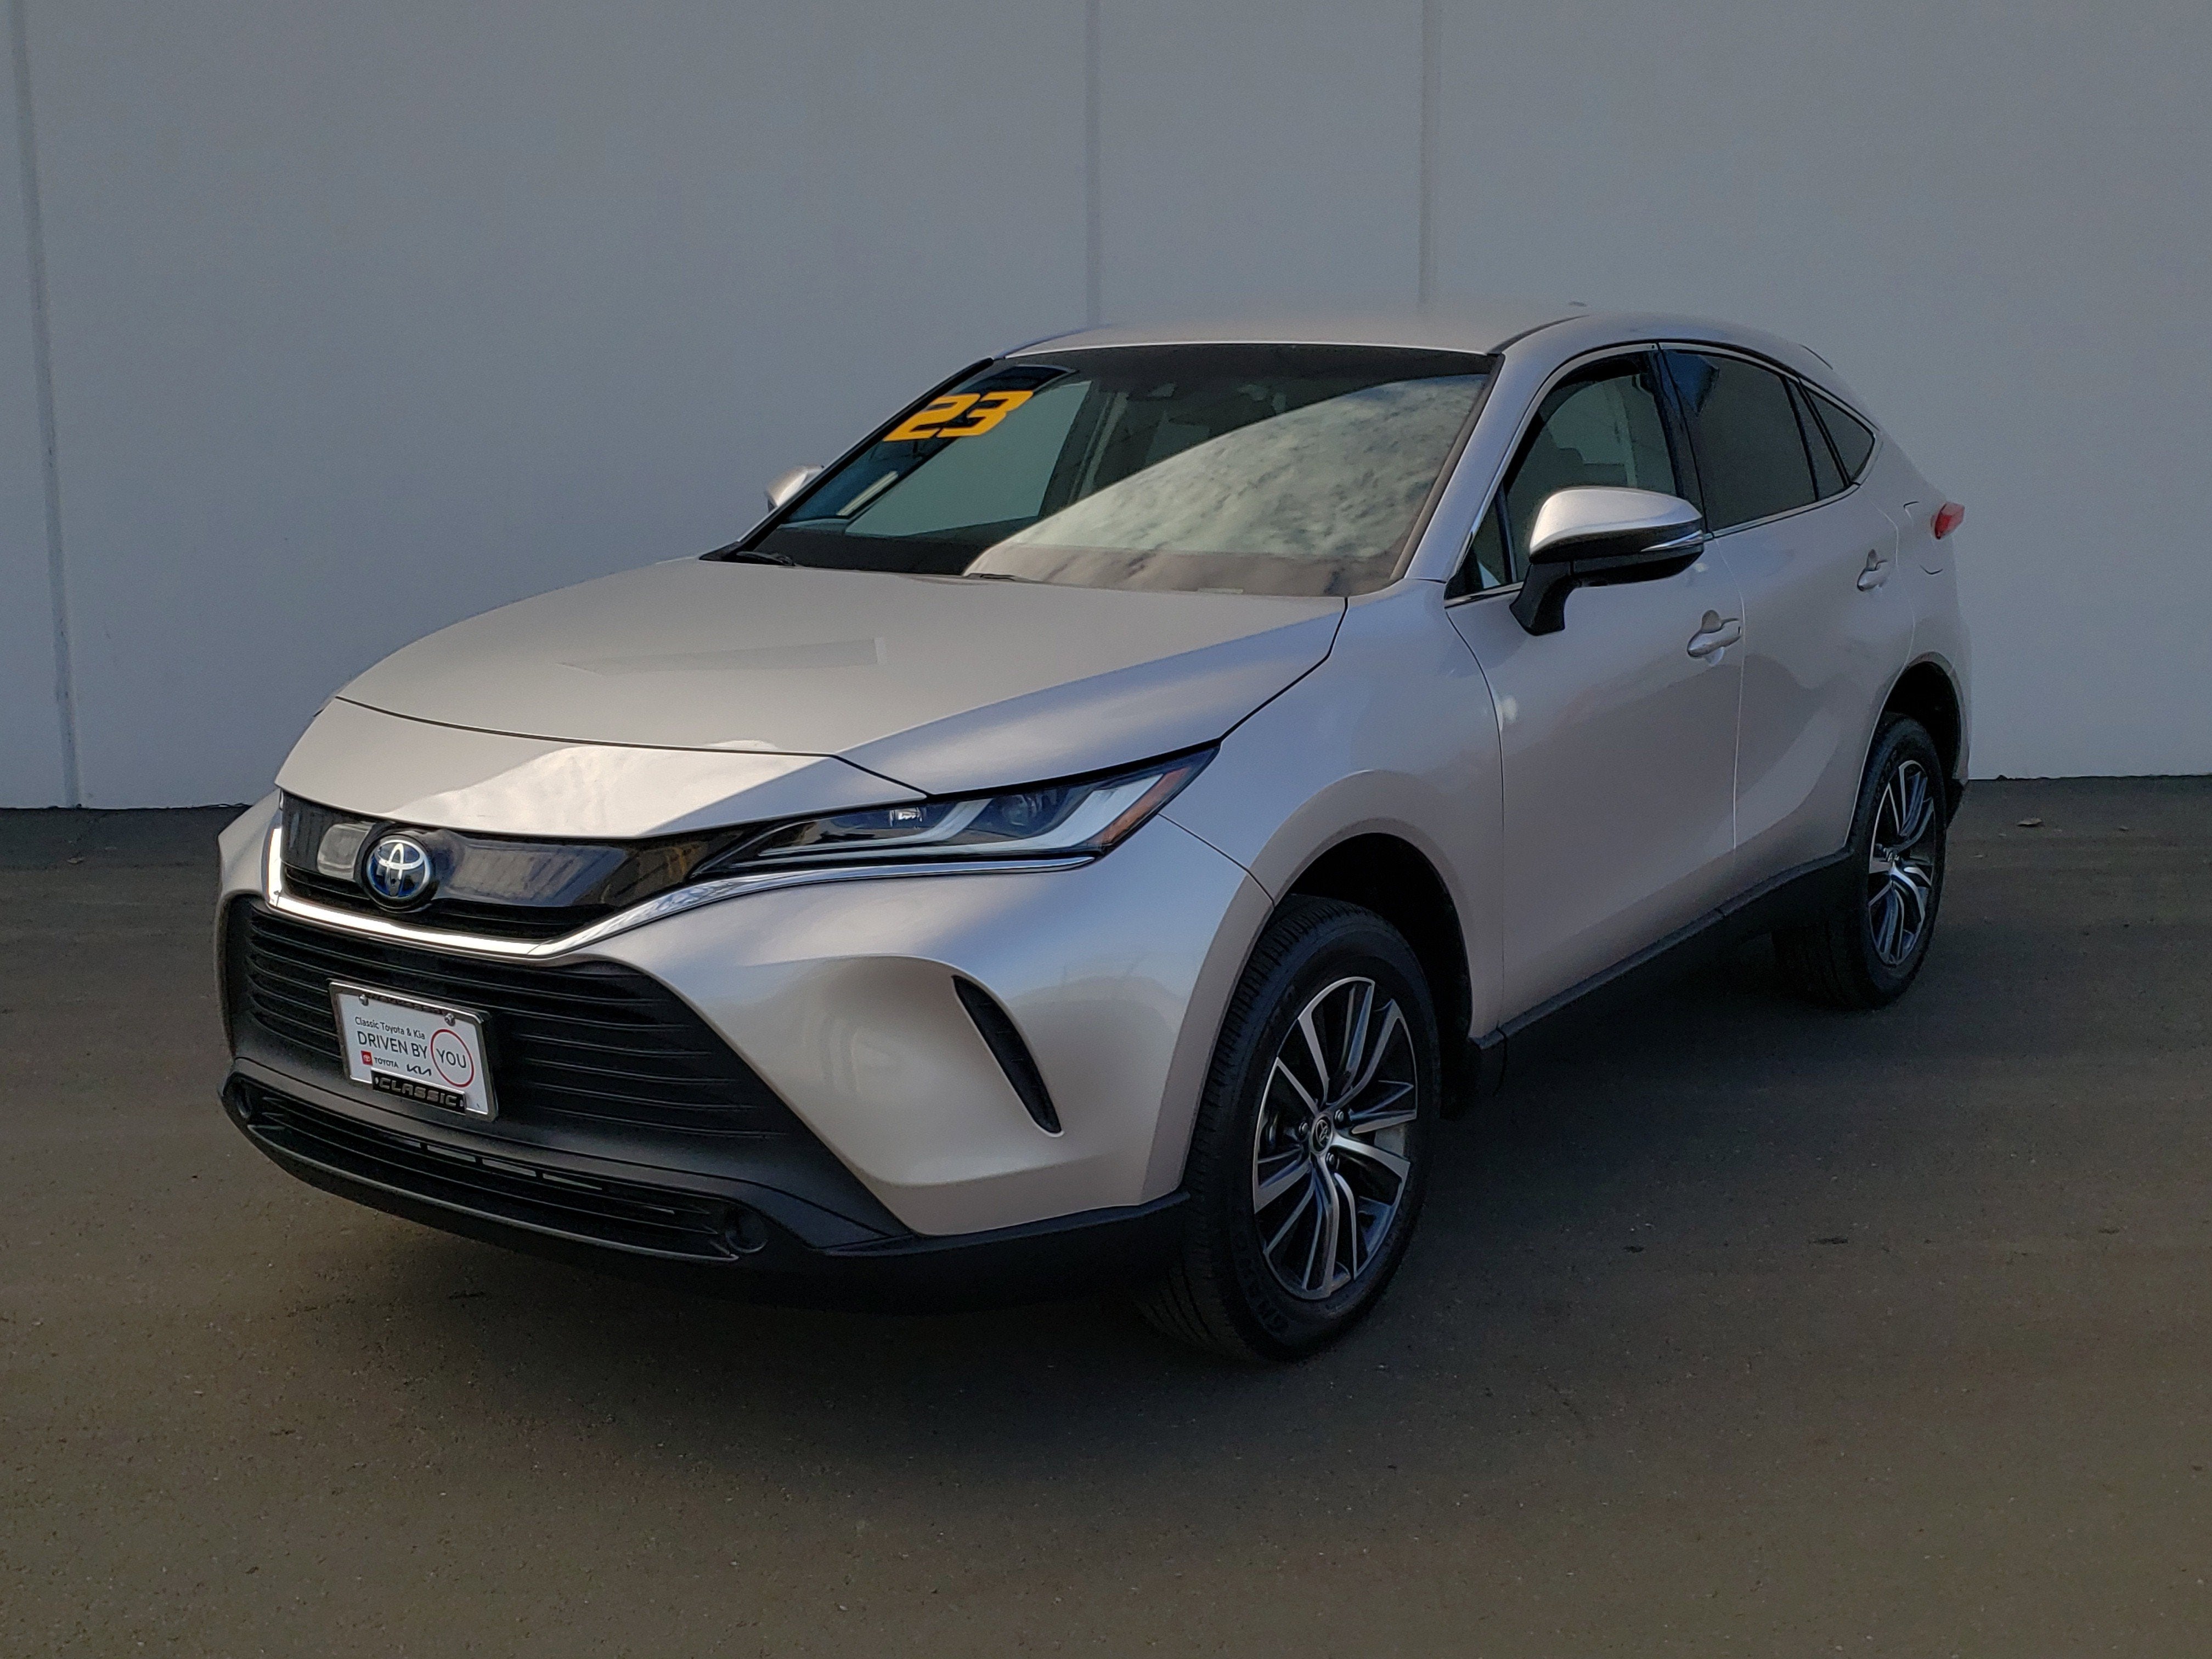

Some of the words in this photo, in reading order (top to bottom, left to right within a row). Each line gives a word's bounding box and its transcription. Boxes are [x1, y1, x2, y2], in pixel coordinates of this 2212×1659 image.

[883, 390, 1034, 442] 23
[354, 1016, 379, 1030] Classic
[380, 1022, 405, 1035] Toyota
[407, 1028, 411, 1036] &
[413, 1029, 426, 1040] Kia
[357, 1030, 408, 1056] DRIVEN
[411, 1042, 428, 1059] BY
[436, 1047, 467, 1069] YOU
[374, 1057, 399, 1069] TOYOTA
[379, 1076, 458, 1108] CLASSIC
